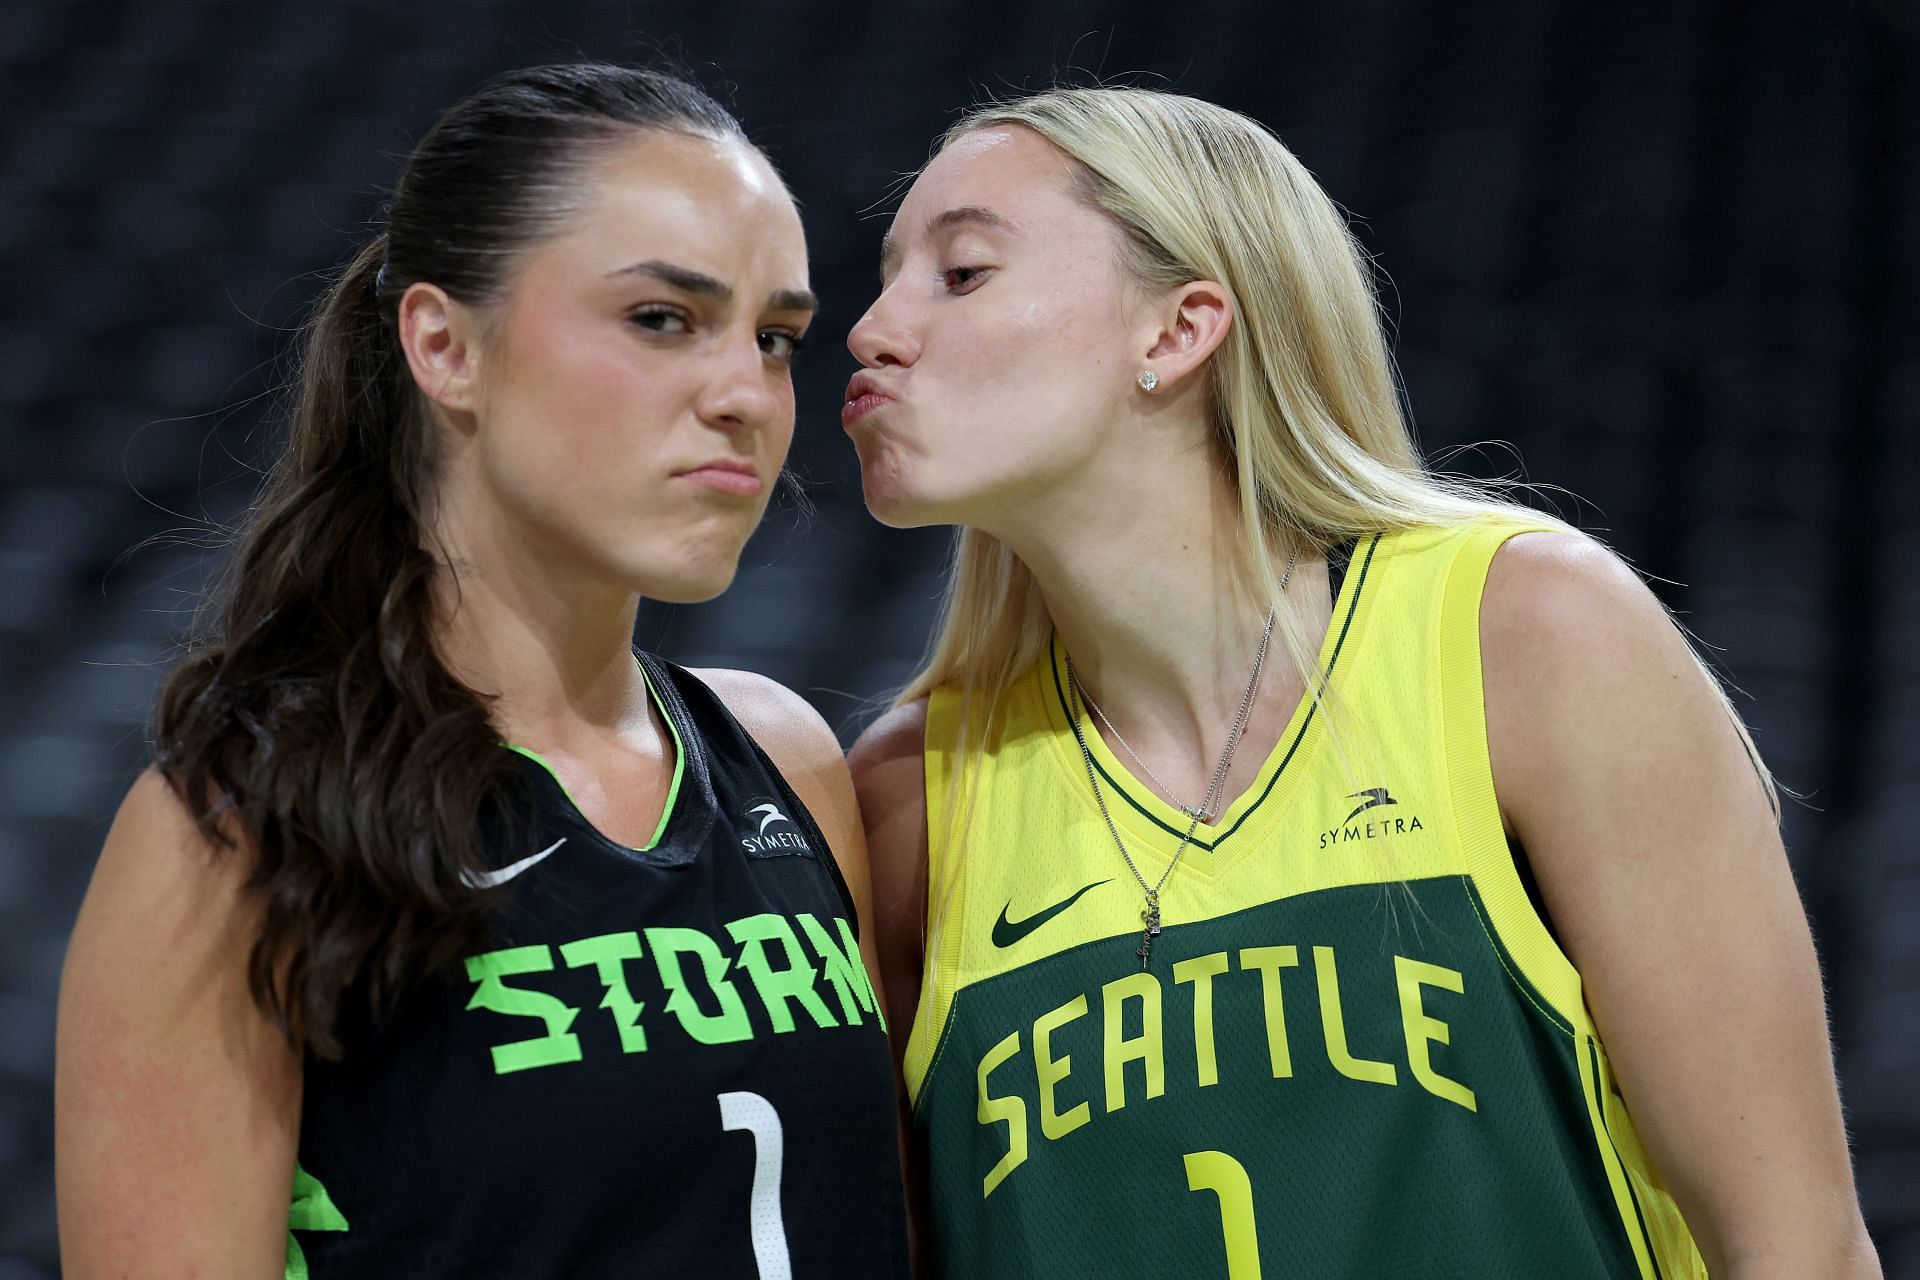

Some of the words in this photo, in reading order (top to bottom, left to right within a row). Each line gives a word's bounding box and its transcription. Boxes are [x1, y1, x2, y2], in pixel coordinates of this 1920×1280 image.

[742, 833, 811, 853] SYMETRA
[1320, 816, 1423, 849] SYMETRA
[465, 914, 888, 1074] STORM
[977, 946, 1477, 1198] SEATTLE
[717, 1091, 792, 1280] 1
[1183, 1150, 1262, 1280] 1
